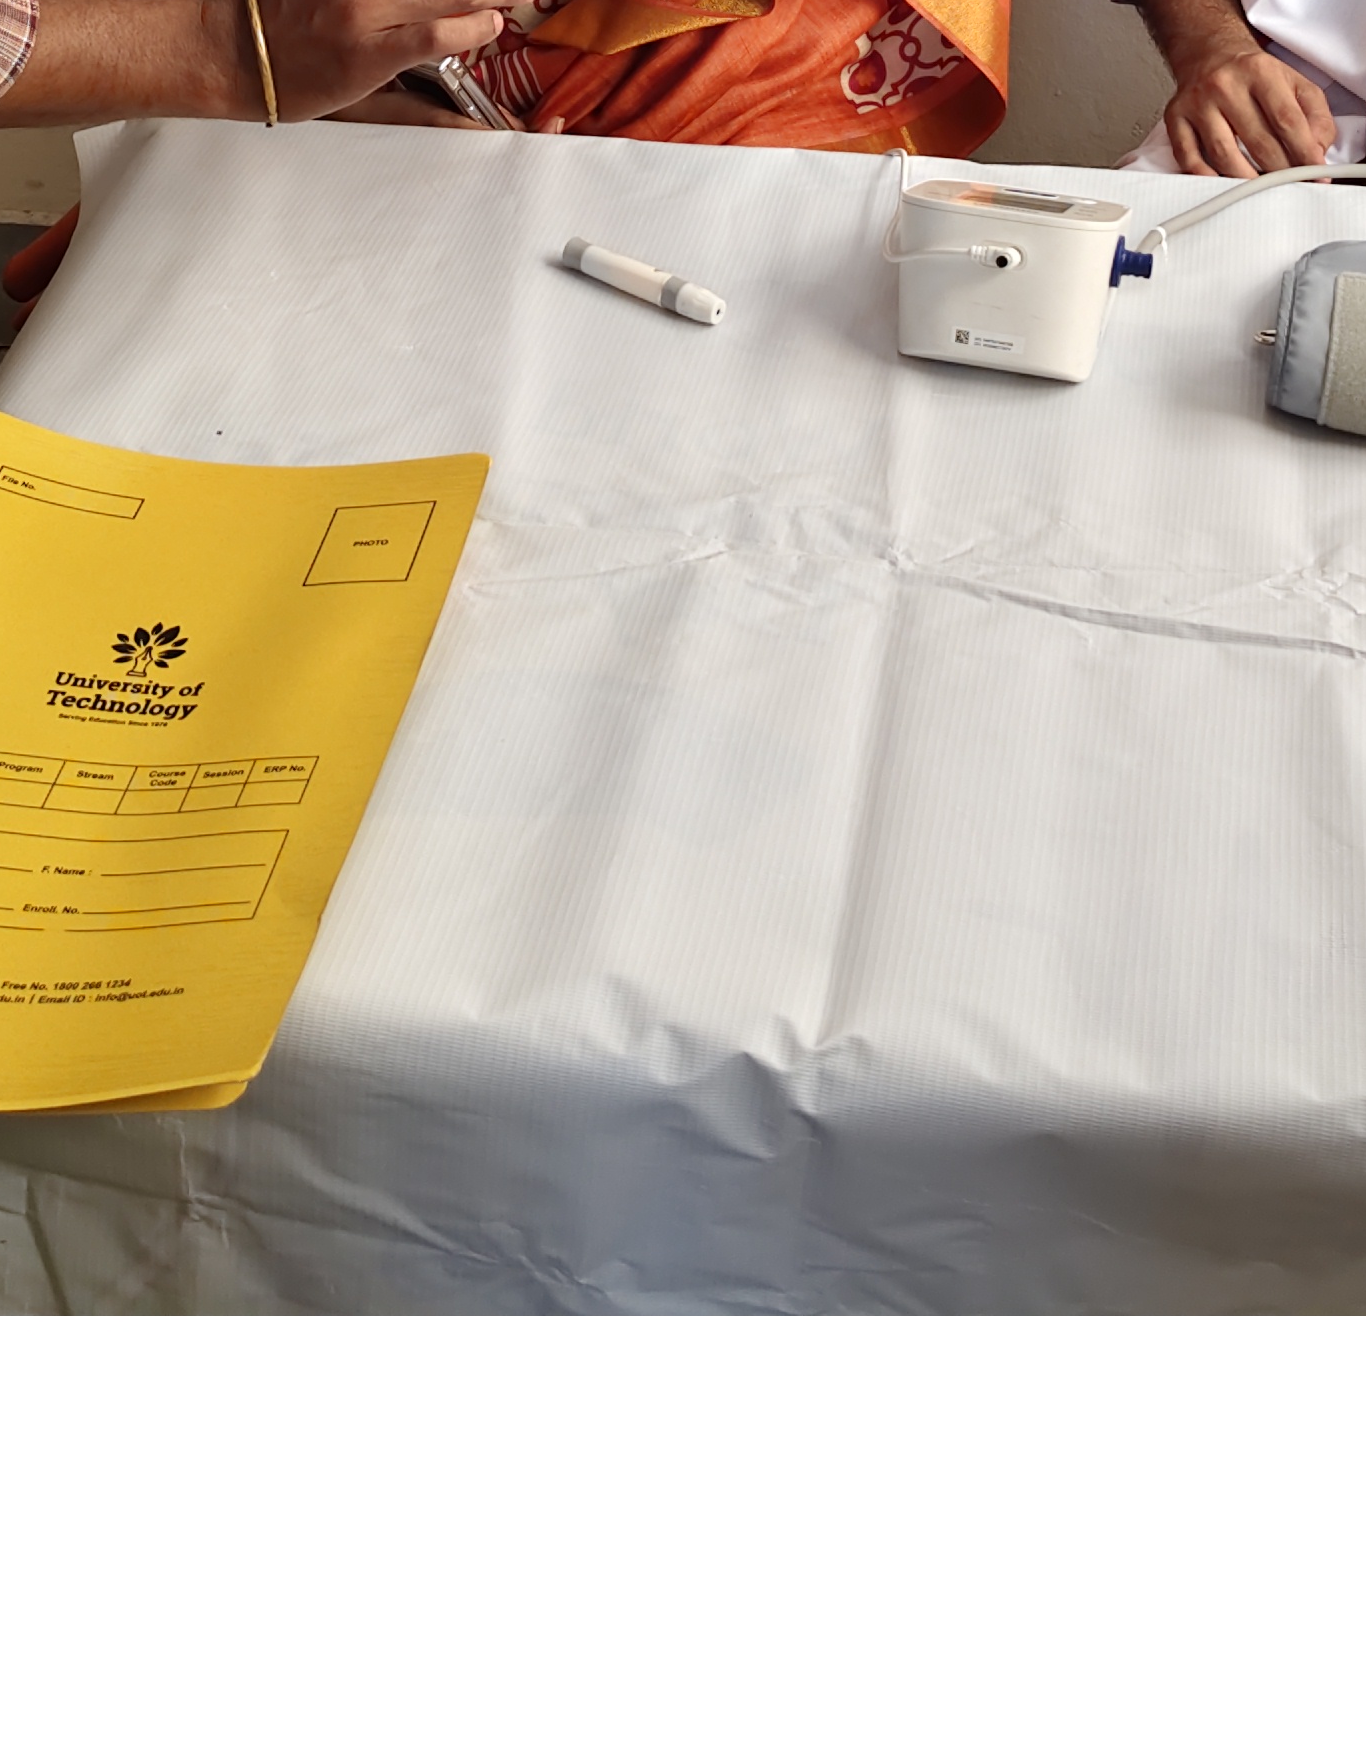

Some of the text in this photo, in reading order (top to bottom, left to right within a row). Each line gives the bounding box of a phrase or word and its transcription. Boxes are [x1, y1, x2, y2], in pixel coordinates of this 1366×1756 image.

[55, 671, 205, 699] University of
[46, 690, 198, 720] Technology
[77, 771, 113, 780] Stream
[203, 770, 244, 778] Session
[149, 778, 178, 787] Code
[54, 867, 85, 875] Name
[23, 904, 79, 914] Enroll. No.
[1, 981, 27, 990] Free
[30, 982, 47, 990] No.
[38, 995, 71, 1004] Email
[73, 995, 85, 1003] ID
